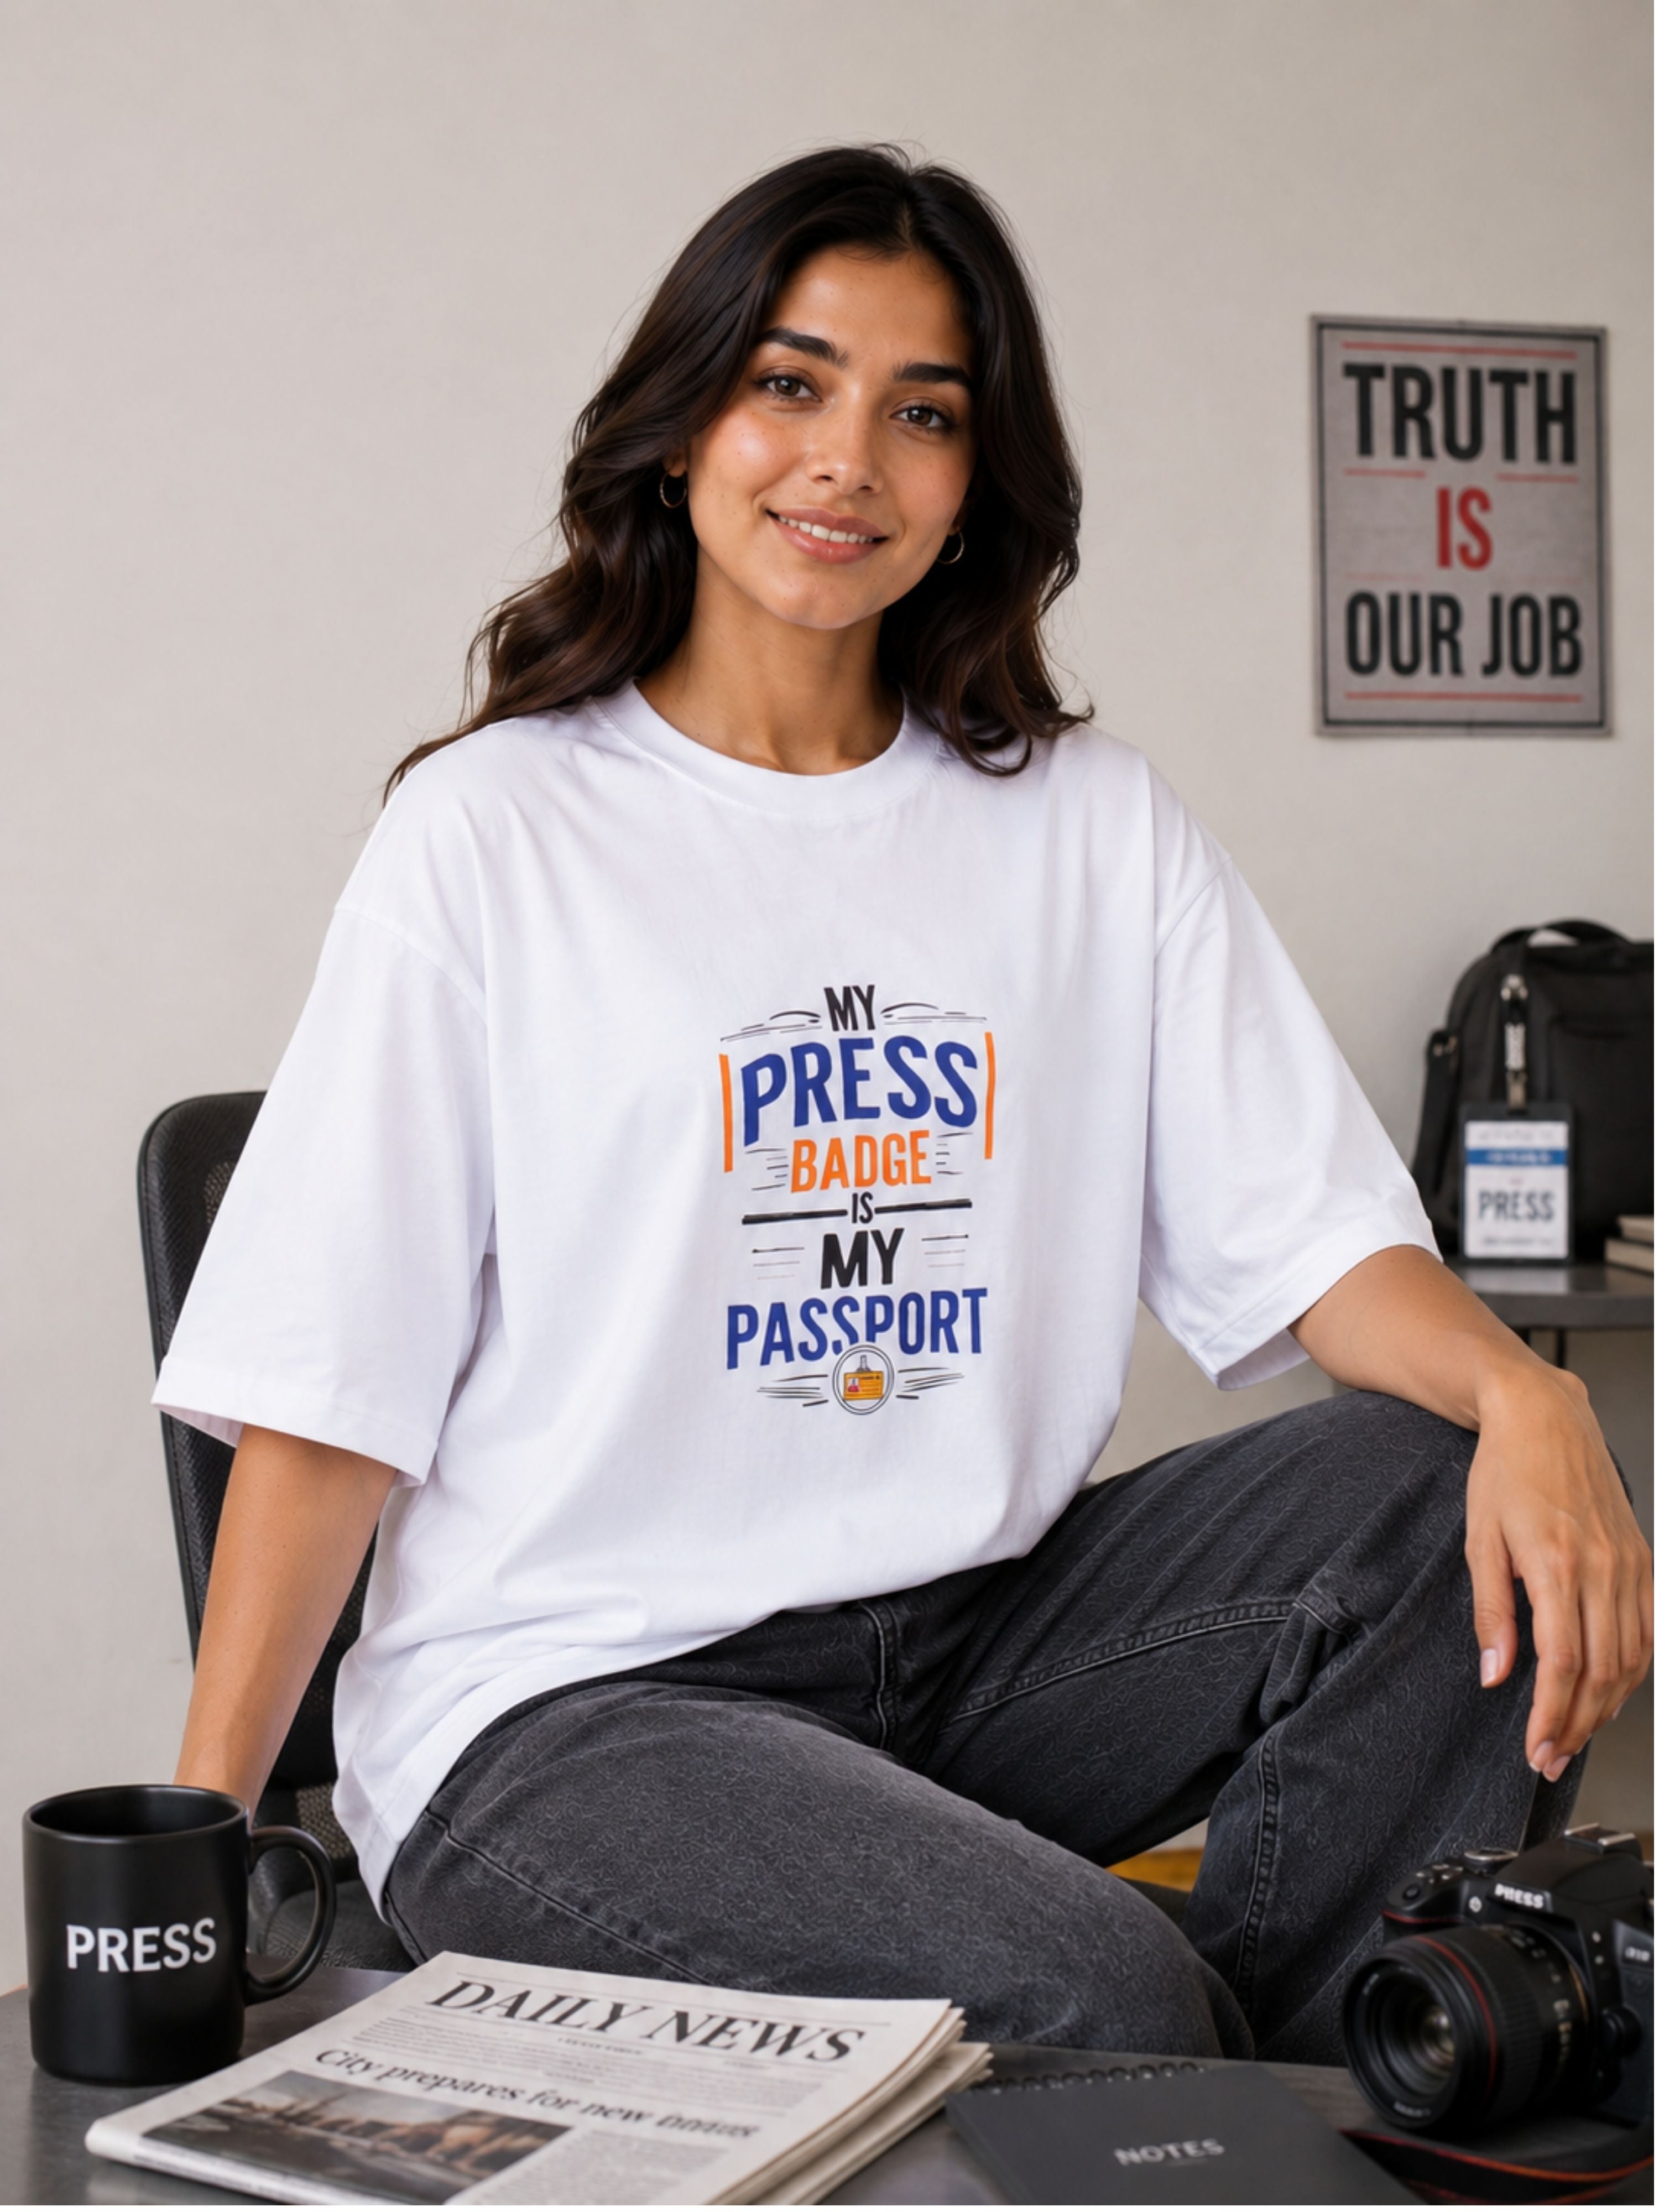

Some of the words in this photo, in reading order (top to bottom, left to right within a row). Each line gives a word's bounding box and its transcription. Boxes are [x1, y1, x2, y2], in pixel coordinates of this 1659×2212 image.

[1343, 362, 1577, 464] TRUTH
[1437, 486, 1494, 571] IS
[1346, 590, 1465, 677] OUR
[1481, 593, 1583, 679] JOB
[823, 984, 876, 1031] MY
[741, 1035, 978, 1147] PRESS
[790, 1130, 931, 1193] BADGE
[852, 1191, 874, 1224] IS
[1478, 1190, 1556, 1222] PRESS
[820, 1228, 905, 1290] MY
[727, 1287, 988, 1370] PASSPORT
[66, 1917, 217, 1972] PRESS
[425, 1980, 653, 2033] DAILY
[639, 2010, 866, 2062] NEWS
[316, 2048, 384, 2075] City
[374, 2067, 526, 2099] prepares
[526, 2089, 580, 2110] for
[580, 2103, 654, 2122] new
[1114, 2138, 1225, 2167] NOTES
